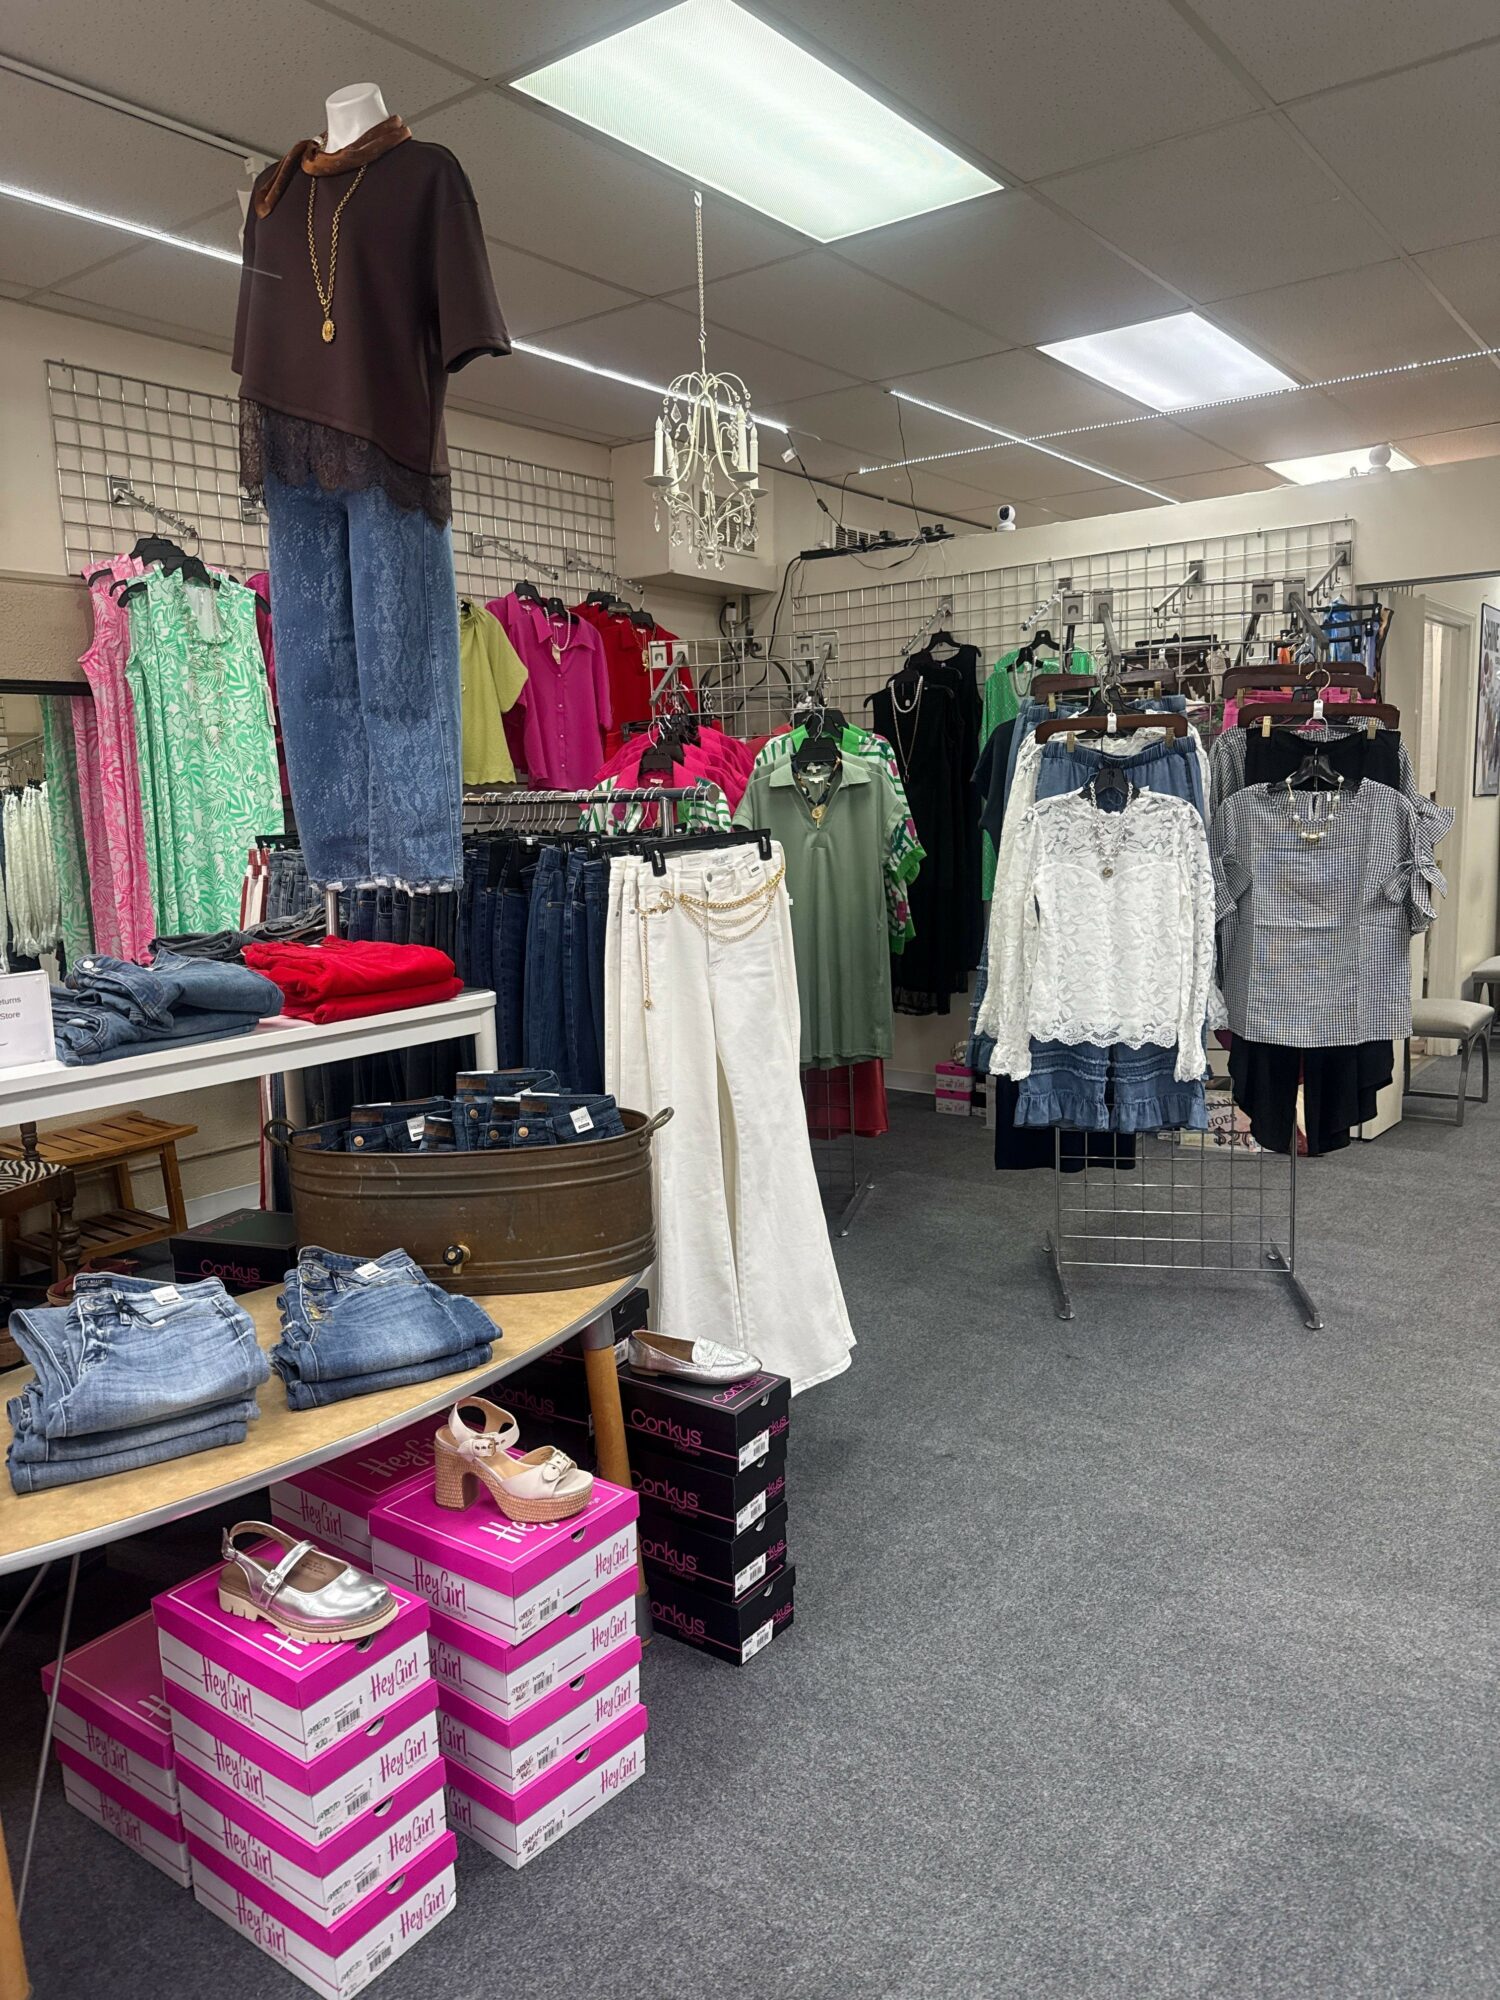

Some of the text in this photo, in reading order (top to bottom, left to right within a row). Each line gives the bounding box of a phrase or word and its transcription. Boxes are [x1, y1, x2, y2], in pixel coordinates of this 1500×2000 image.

[1207, 1113, 1238, 1128] HOES
[200, 1259, 260, 1283] Corkys
[631, 1409, 702, 1447] Corkys
[357, 1438, 435, 1478] HeyGi
[300, 1491, 343, 1538] HeyGirl
[595, 1538, 629, 1578] HeyGirl
[640, 1537, 697, 1571] orkys
[412, 1557, 466, 1612] HeyGirl
[591, 1611, 627, 1652] HeyGirl
[651, 1602, 705, 1634] orkys
[370, 1652, 418, 1702] HeyGirl
[430, 1642, 463, 1684] yGirl
[202, 1655, 253, 1719] HeyGirl
[595, 1680, 631, 1722] HeyGirl
[86, 1720, 130, 1775] HeyGirl
[380, 1731, 427, 1783] HeyGirl
[441, 1714, 467, 1757] Girl
[214, 1737, 265, 1801] HeyGirl
[600, 1751, 637, 1795] HeyGirl
[448, 1785, 473, 1829] Girl
[222, 1815, 274, 1880] HeyGirl
[388, 1808, 435, 1862] HeyGirl
[236, 1891, 287, 1957] HeyGirl
[400, 1884, 446, 1939] HeyGirl
